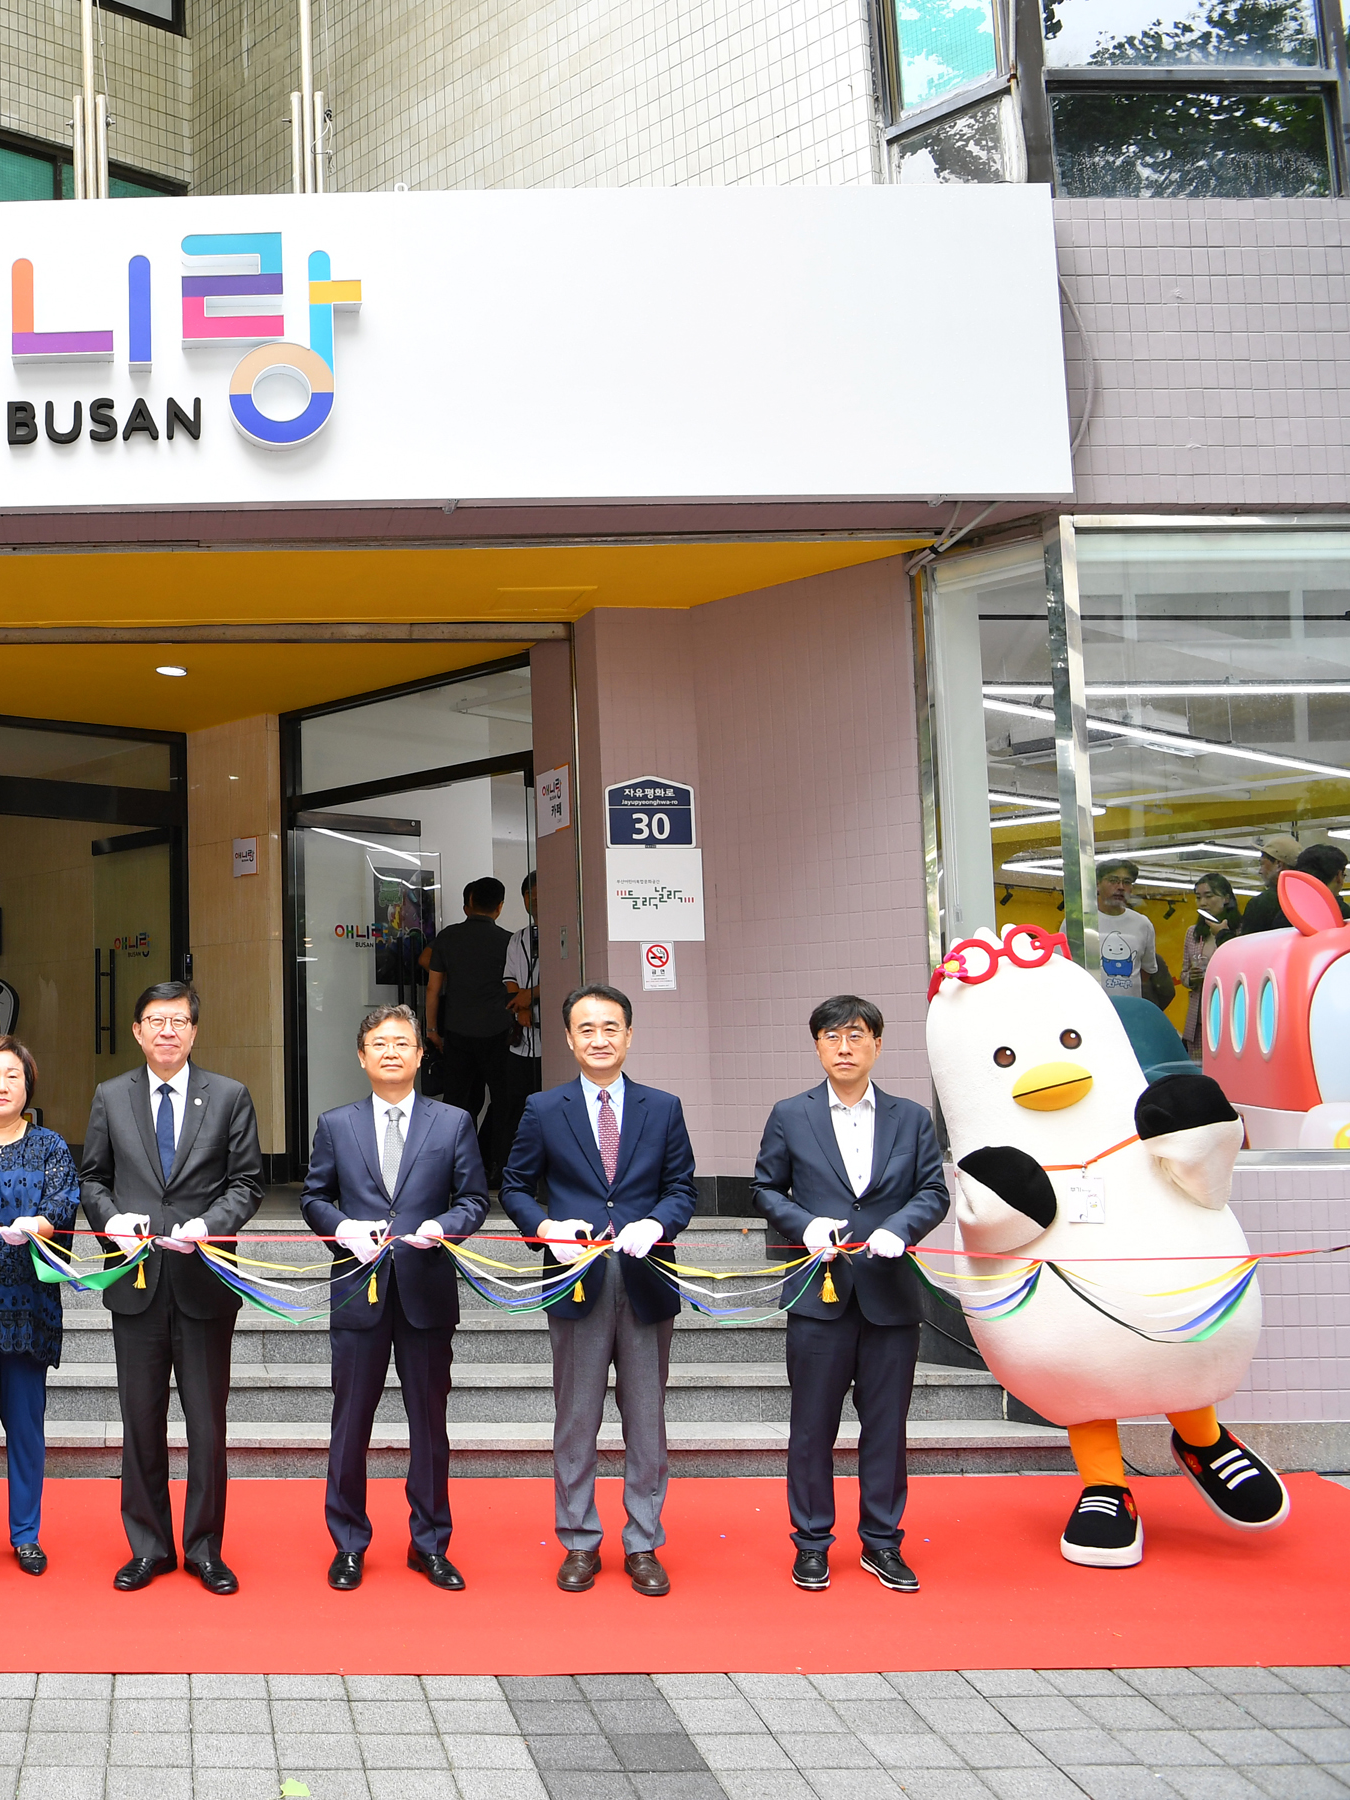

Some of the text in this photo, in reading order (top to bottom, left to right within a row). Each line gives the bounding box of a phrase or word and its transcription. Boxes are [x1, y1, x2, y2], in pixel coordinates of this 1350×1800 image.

[6, 396, 202, 446] BUSAN
[542, 777, 563, 799] 애니랑
[623, 788, 676, 799] 자유평화로
[551, 802, 562, 818] 카페
[632, 812, 671, 840] 30
[114, 932, 152, 958] 애니랑
[335, 922, 388, 950] 애니랑
